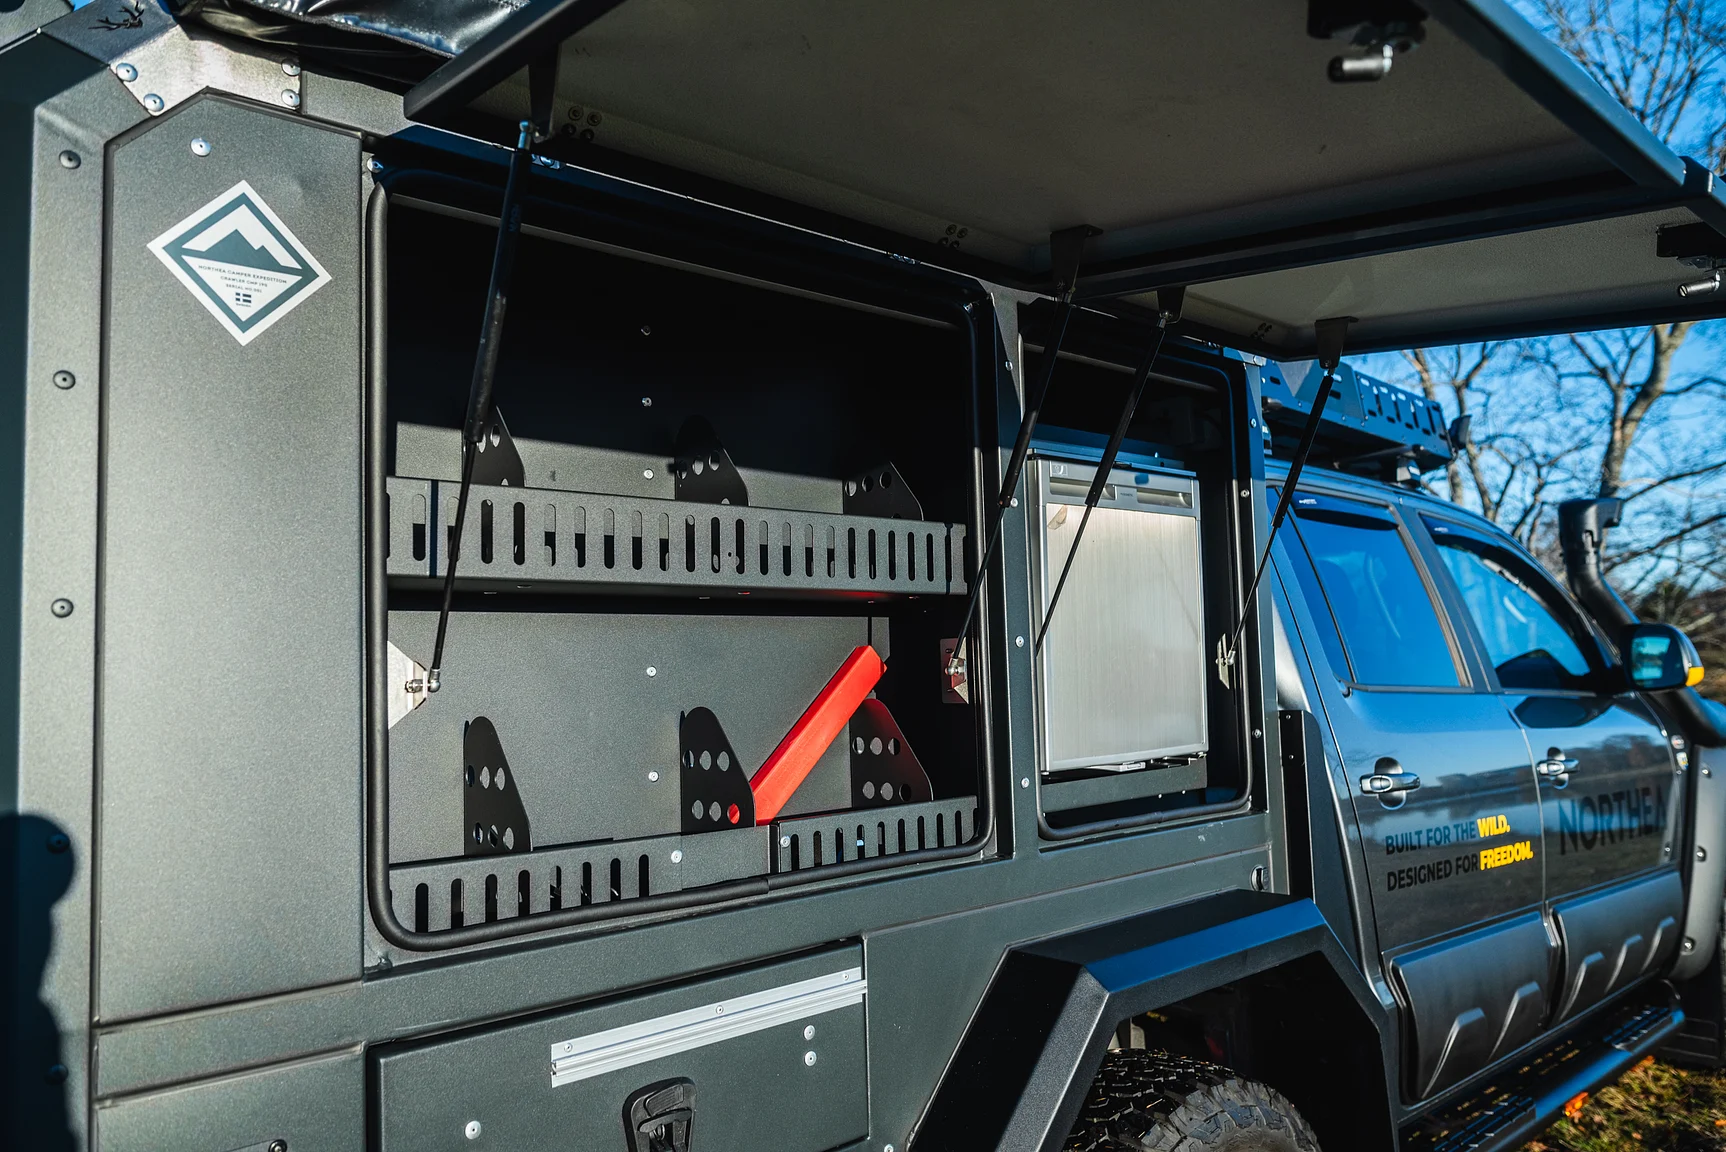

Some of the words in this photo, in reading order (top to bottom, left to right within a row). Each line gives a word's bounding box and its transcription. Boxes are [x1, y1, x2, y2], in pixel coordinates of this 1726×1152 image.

[198, 265, 226, 273] NORTHEA
[227, 270, 251, 278] CAMPER
[253, 275, 287, 284] EXPEDITION
[220, 275, 245, 284] CRAWLER
[1385, 829, 1423, 855] BUILT
[1426, 824, 1452, 846] FOR
[1453, 820, 1477, 843] THE
[1476, 814, 1511, 839] WILD.
[1386, 860, 1453, 892] DESIGNED
[1455, 853, 1478, 874] FOR
[1479, 841, 1534, 871] FREEDOM.
